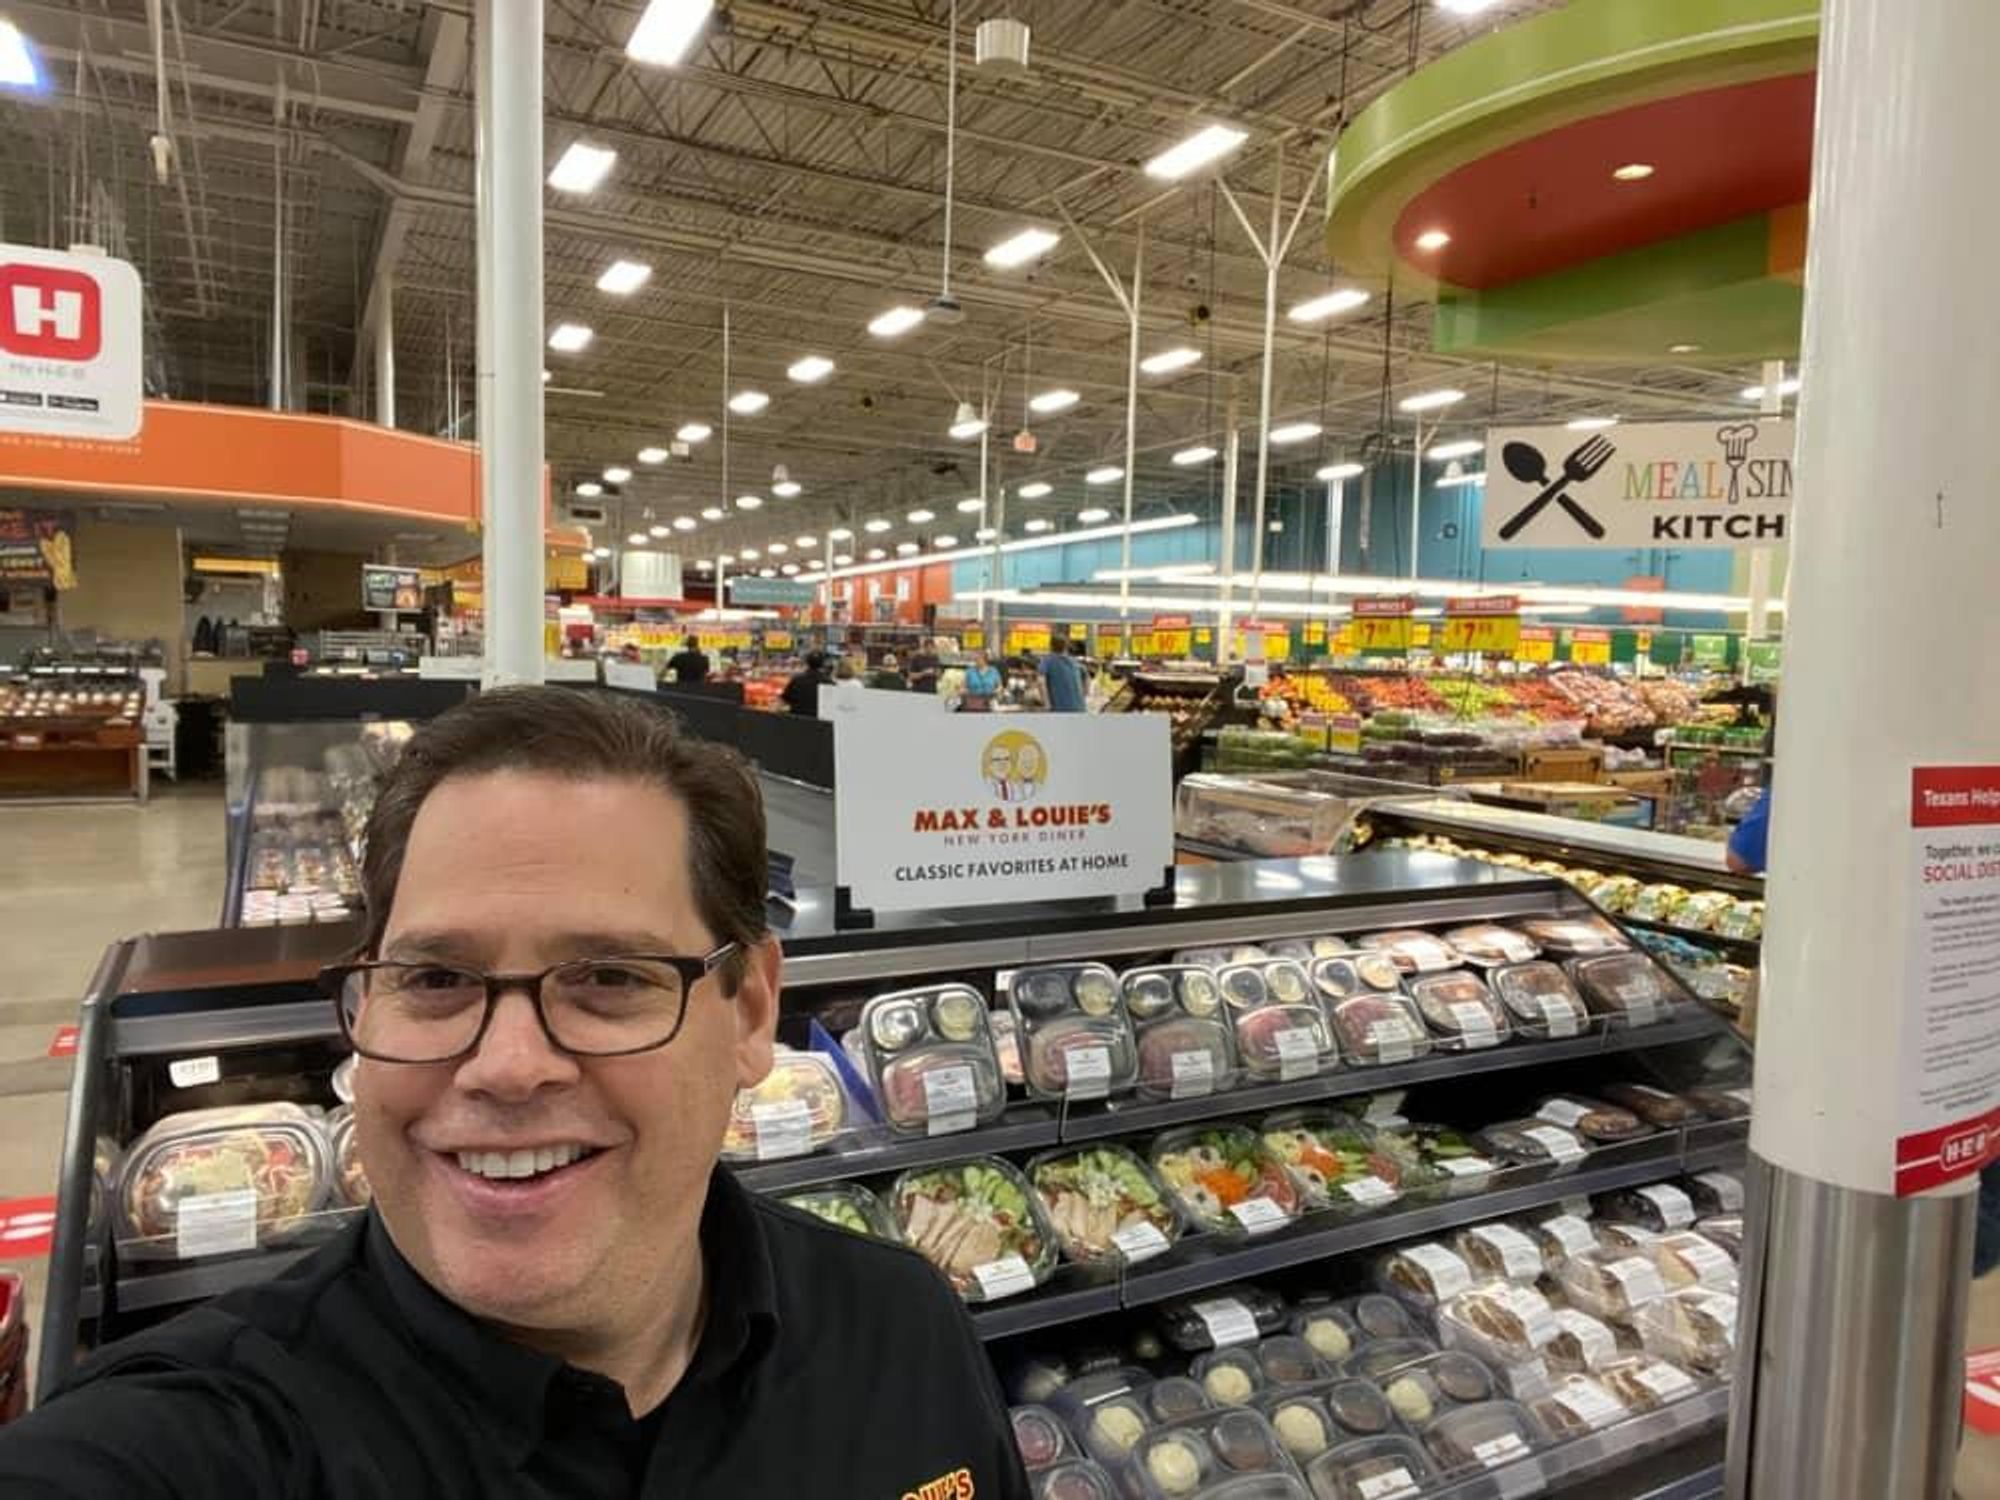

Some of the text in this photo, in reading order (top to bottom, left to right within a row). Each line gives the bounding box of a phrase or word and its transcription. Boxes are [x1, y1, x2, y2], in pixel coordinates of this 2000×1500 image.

[11, 284, 83, 340] H
[1621, 461, 1724, 500] MEAL
[1652, 514, 1785, 539] KITCH
[914, 804, 1112, 832] MAX & LOUIE'S
[944, 828, 1086, 847] NEW YORK DINER
[895, 853, 1128, 882] CLASSIC FAVORITES AT HOME
[1923, 862, 1974, 883] SOCIAL
